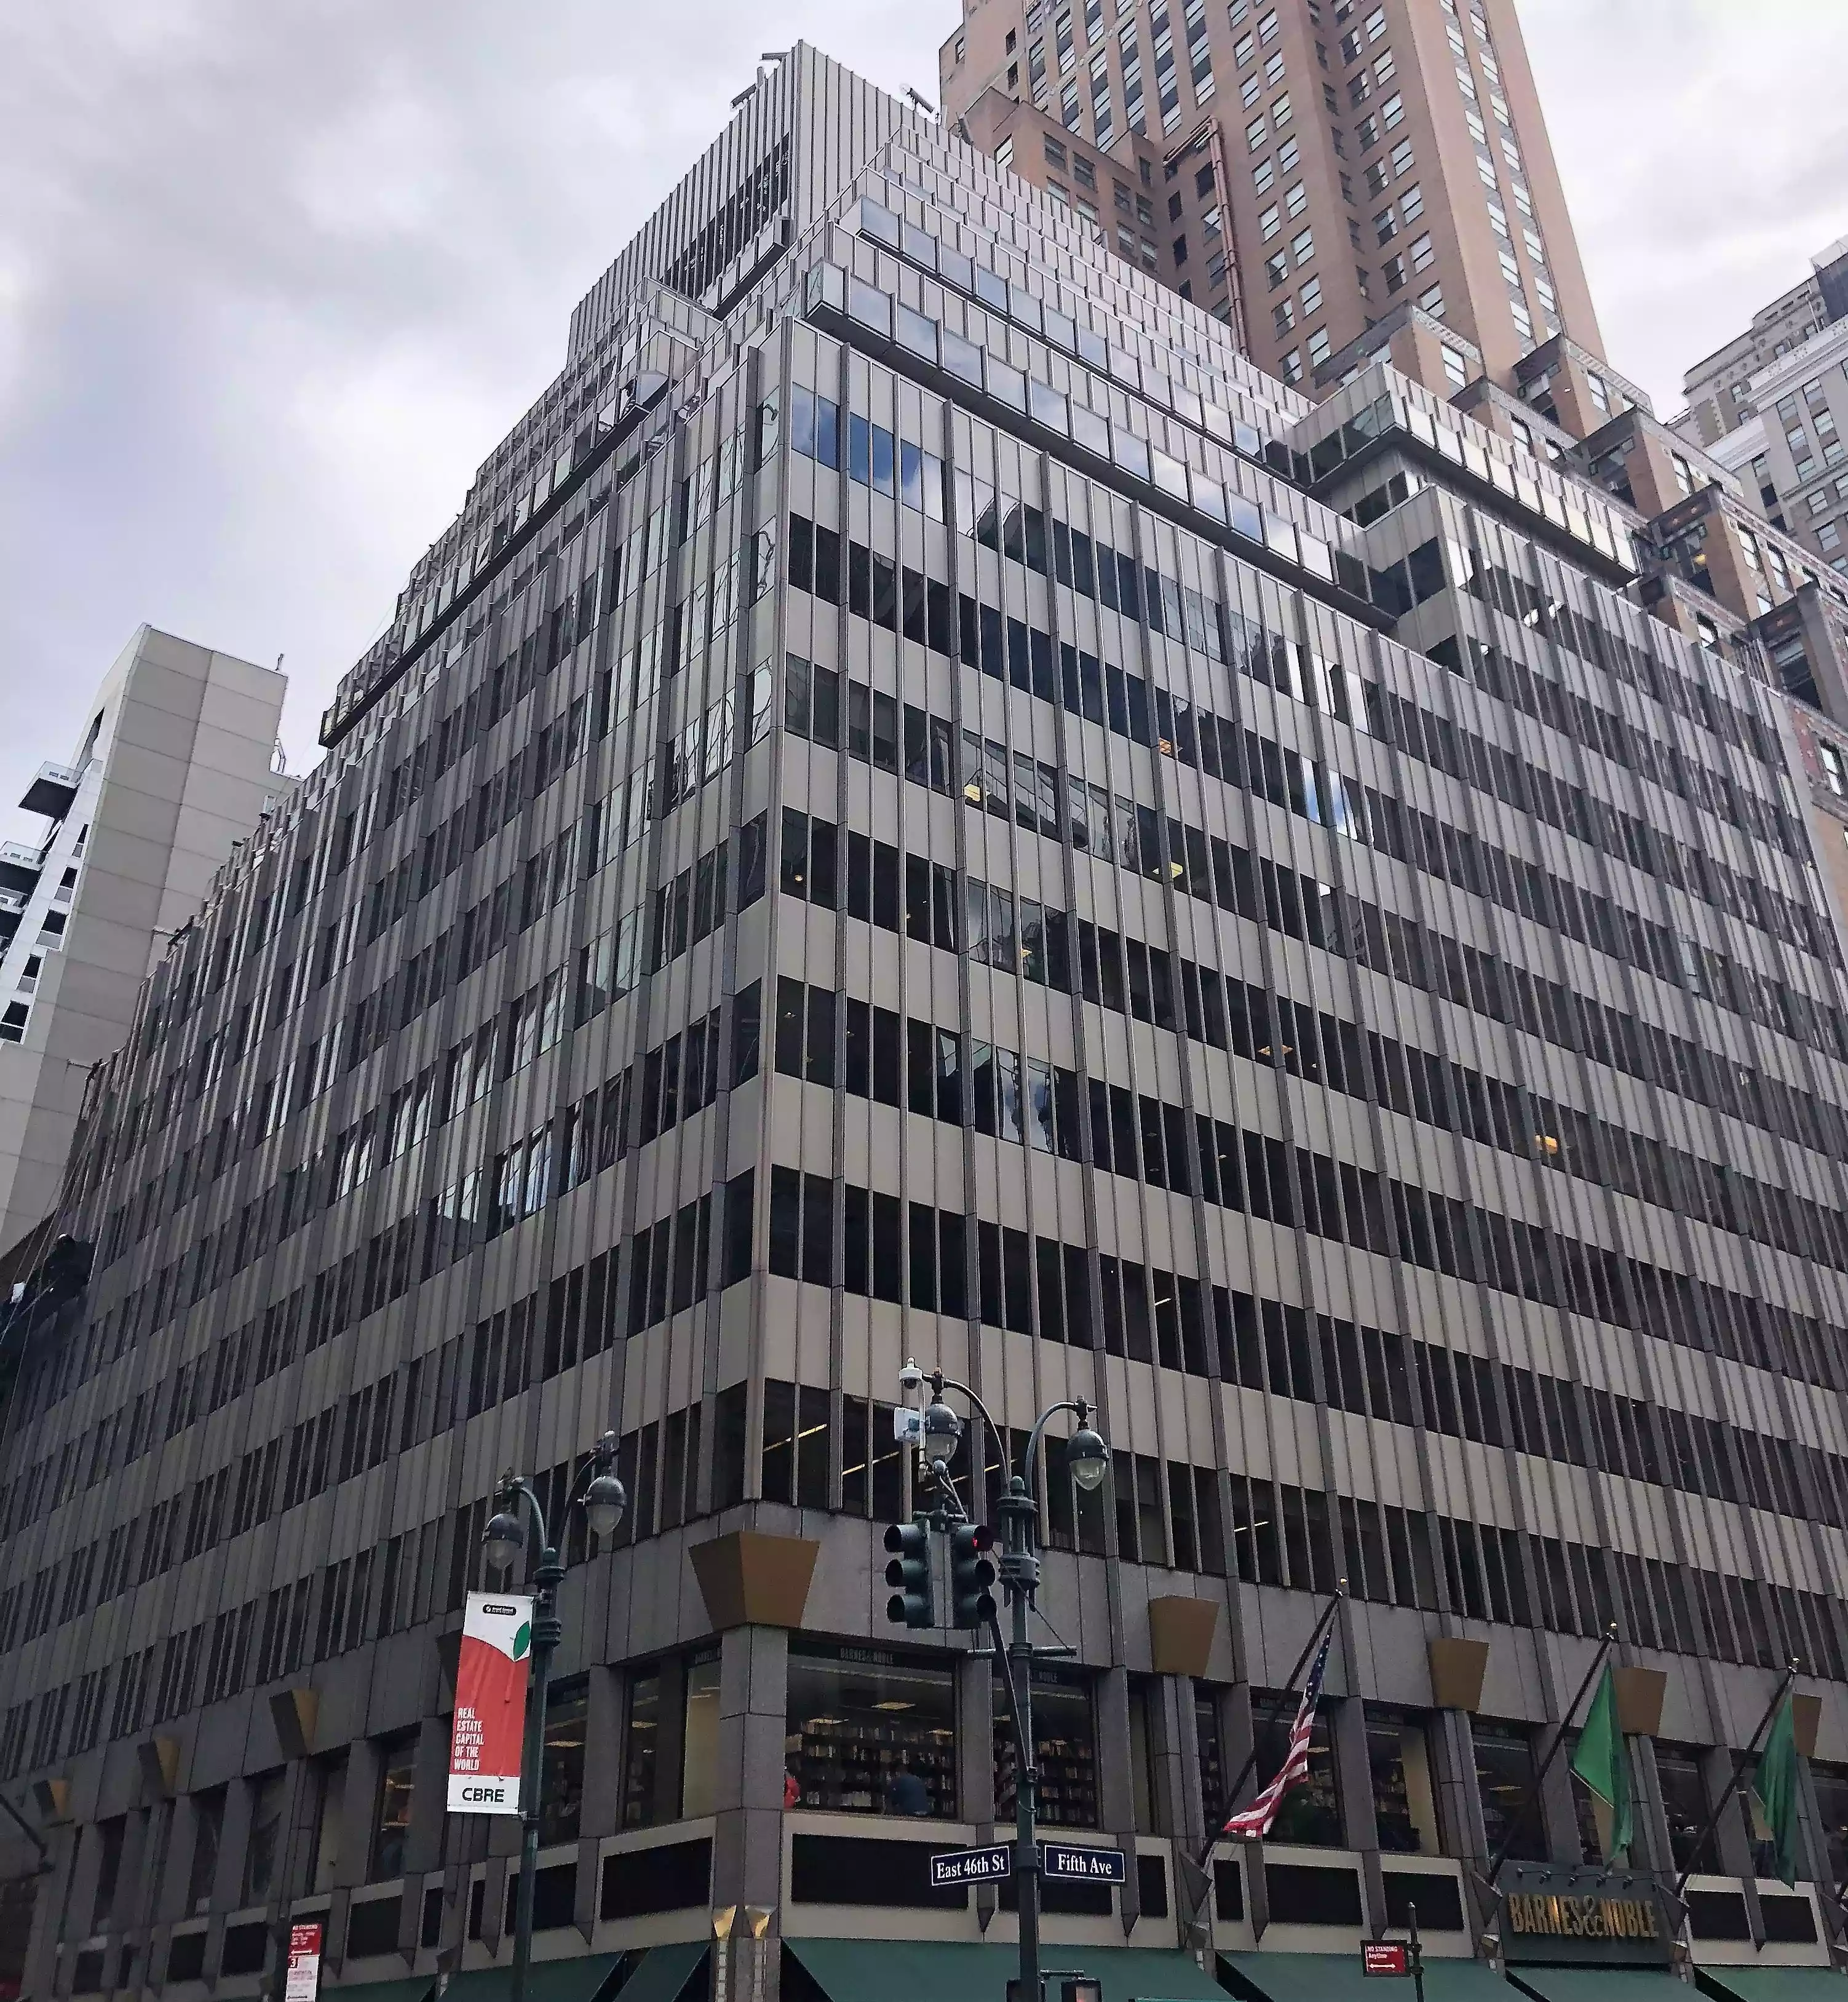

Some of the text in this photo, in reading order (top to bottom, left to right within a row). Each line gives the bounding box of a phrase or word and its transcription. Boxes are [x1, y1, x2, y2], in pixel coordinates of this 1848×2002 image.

[458, 1707, 475, 1719] REAL
[456, 1720, 483, 1732] ESTATE
[456, 1733, 484, 1745] CAPITAL
[454, 1746, 479, 1758] OF THE
[454, 1758, 480, 1771] WORLD
[462, 1787, 505, 1803] CBRE
[937, 1854, 1005, 1879] East 46th St
[1057, 1853, 1112, 1874] Fifth Ave
[1509, 1892, 1584, 1936] BARNES
